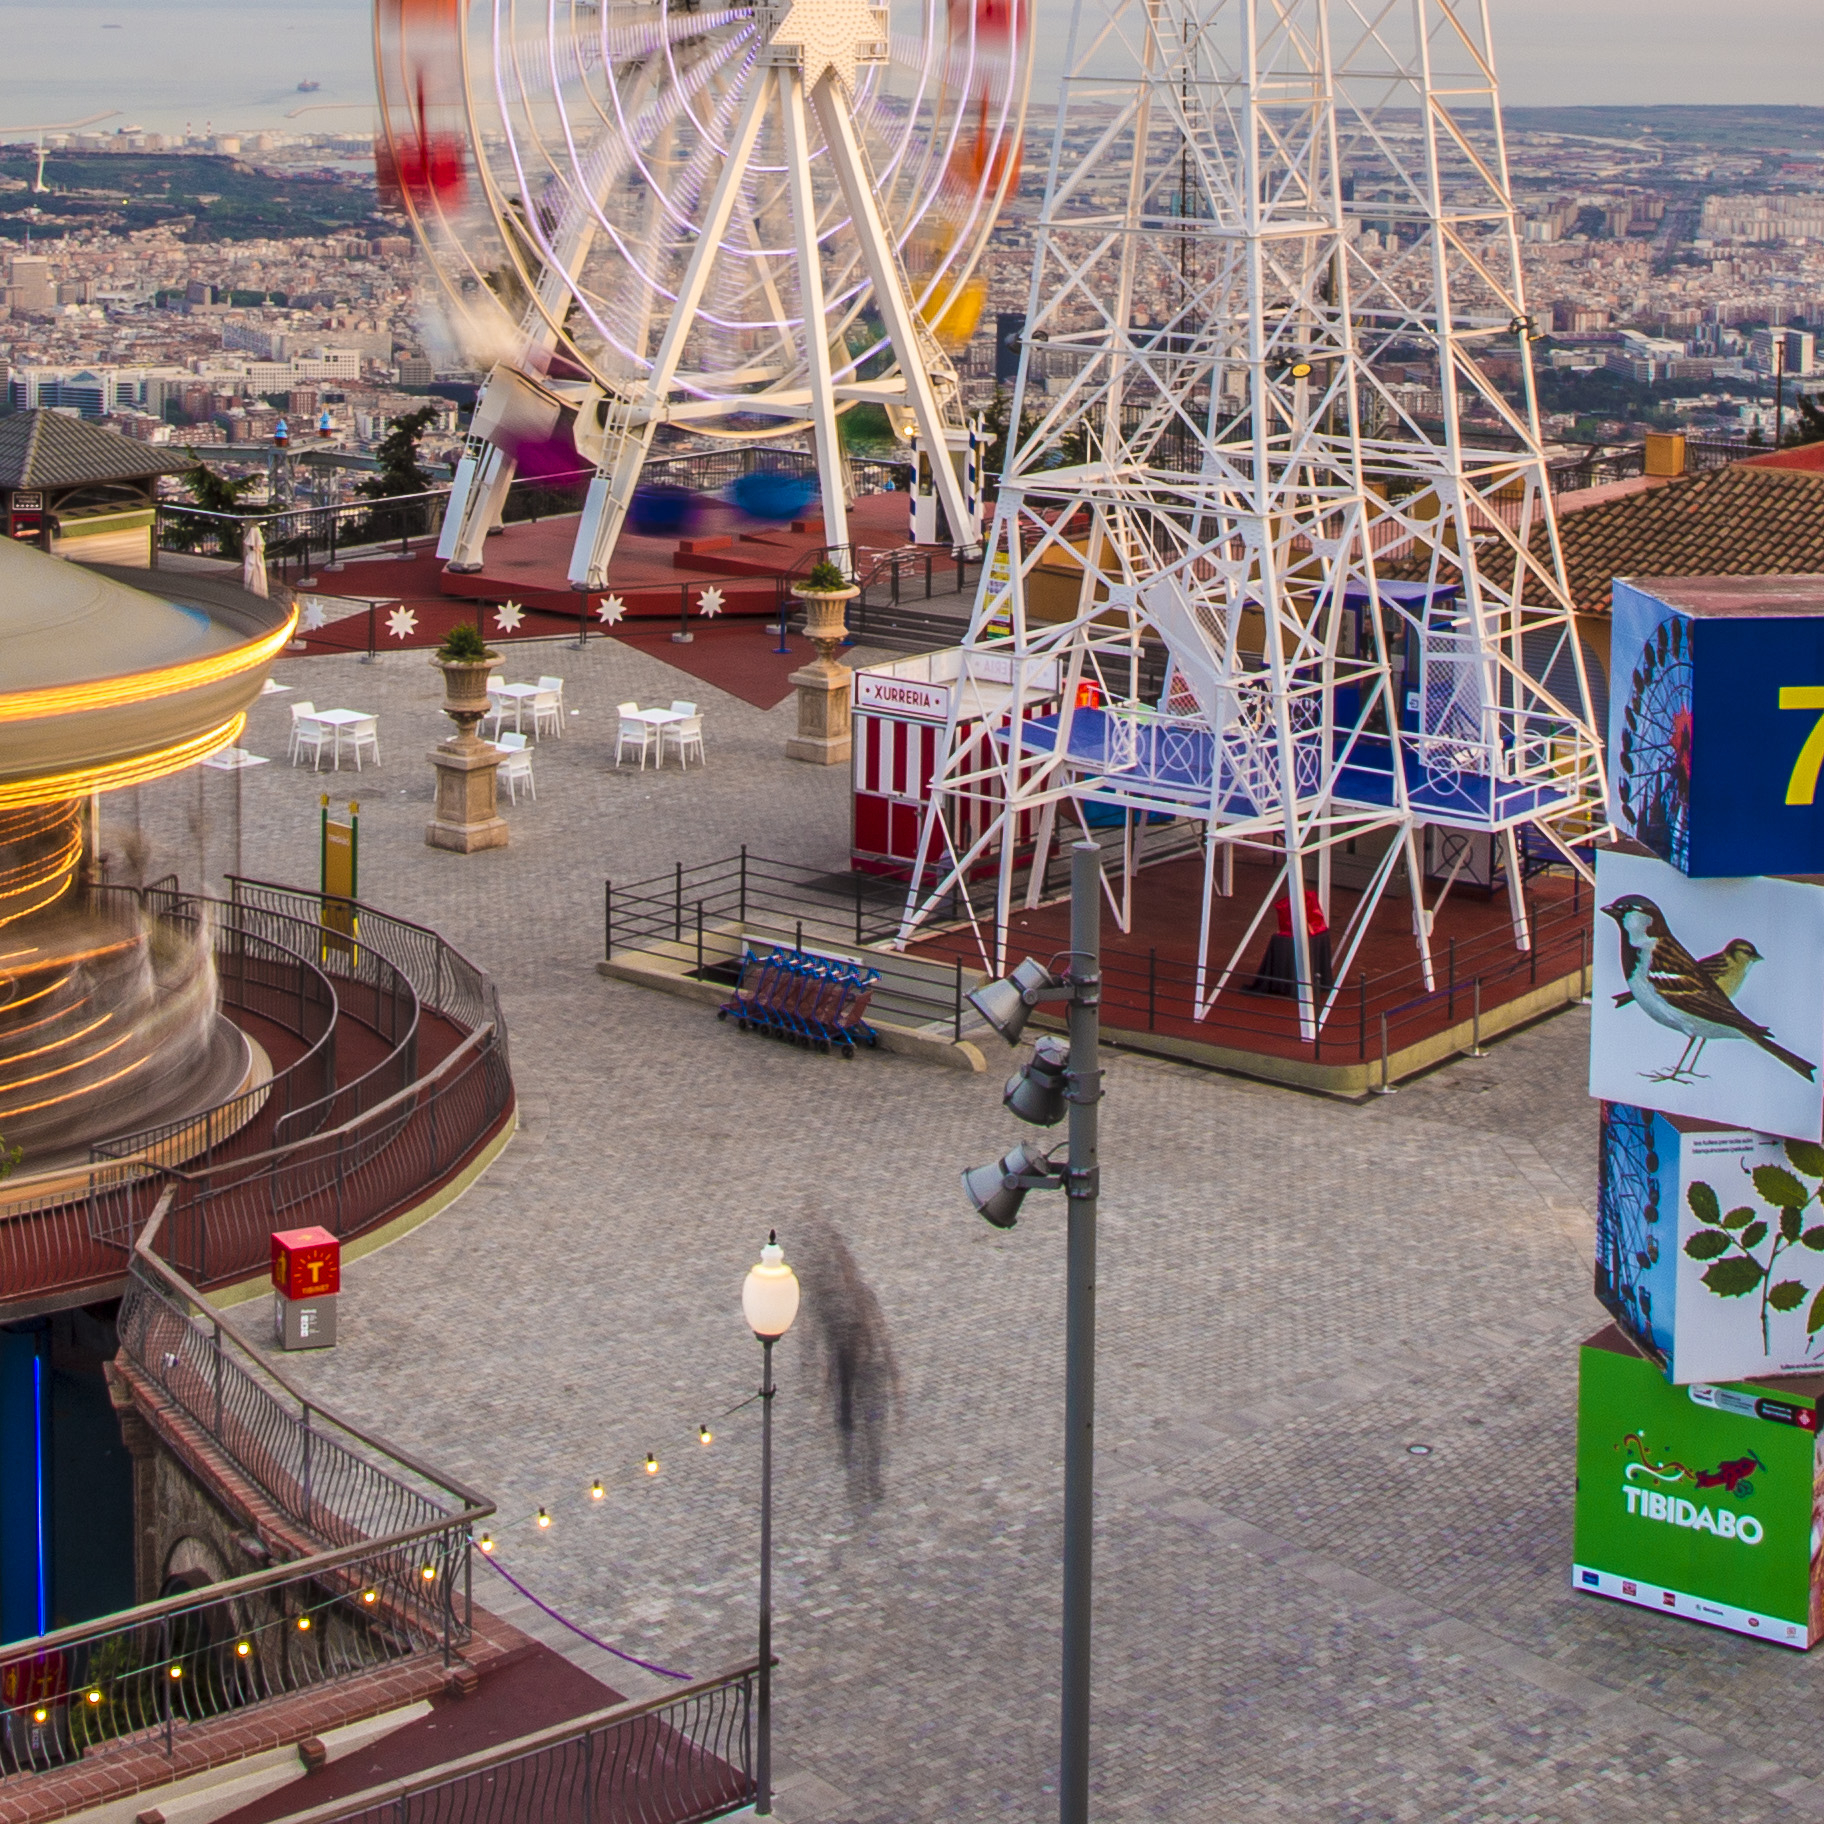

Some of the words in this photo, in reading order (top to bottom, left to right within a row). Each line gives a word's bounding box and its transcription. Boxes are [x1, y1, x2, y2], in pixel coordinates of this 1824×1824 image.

[874, 684, 931, 708] XURRERIA
[307, 1260, 324, 1284] T
[1622, 1484, 1764, 1546] TIBIDABO
